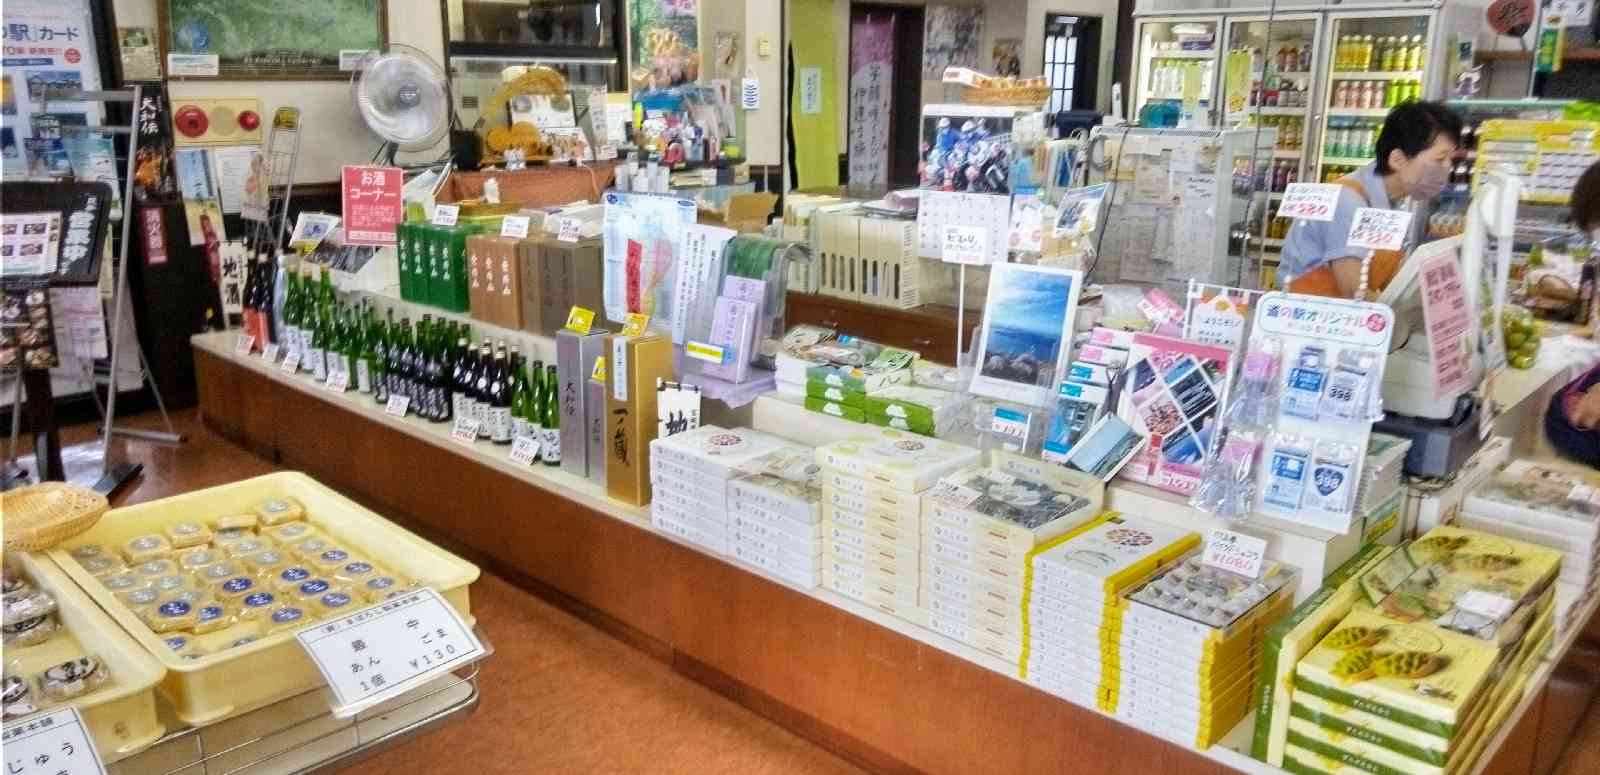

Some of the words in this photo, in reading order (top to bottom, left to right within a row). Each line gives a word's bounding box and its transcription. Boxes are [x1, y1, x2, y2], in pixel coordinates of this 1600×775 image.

[360, 170, 386, 186] お酒
[349, 187, 398, 202] コーナー
[351, 655, 381, 674] あん
[421, 627, 449, 646] ごま
[359, 672, 386, 692] 1個
[408, 643, 456, 670] ¥130
